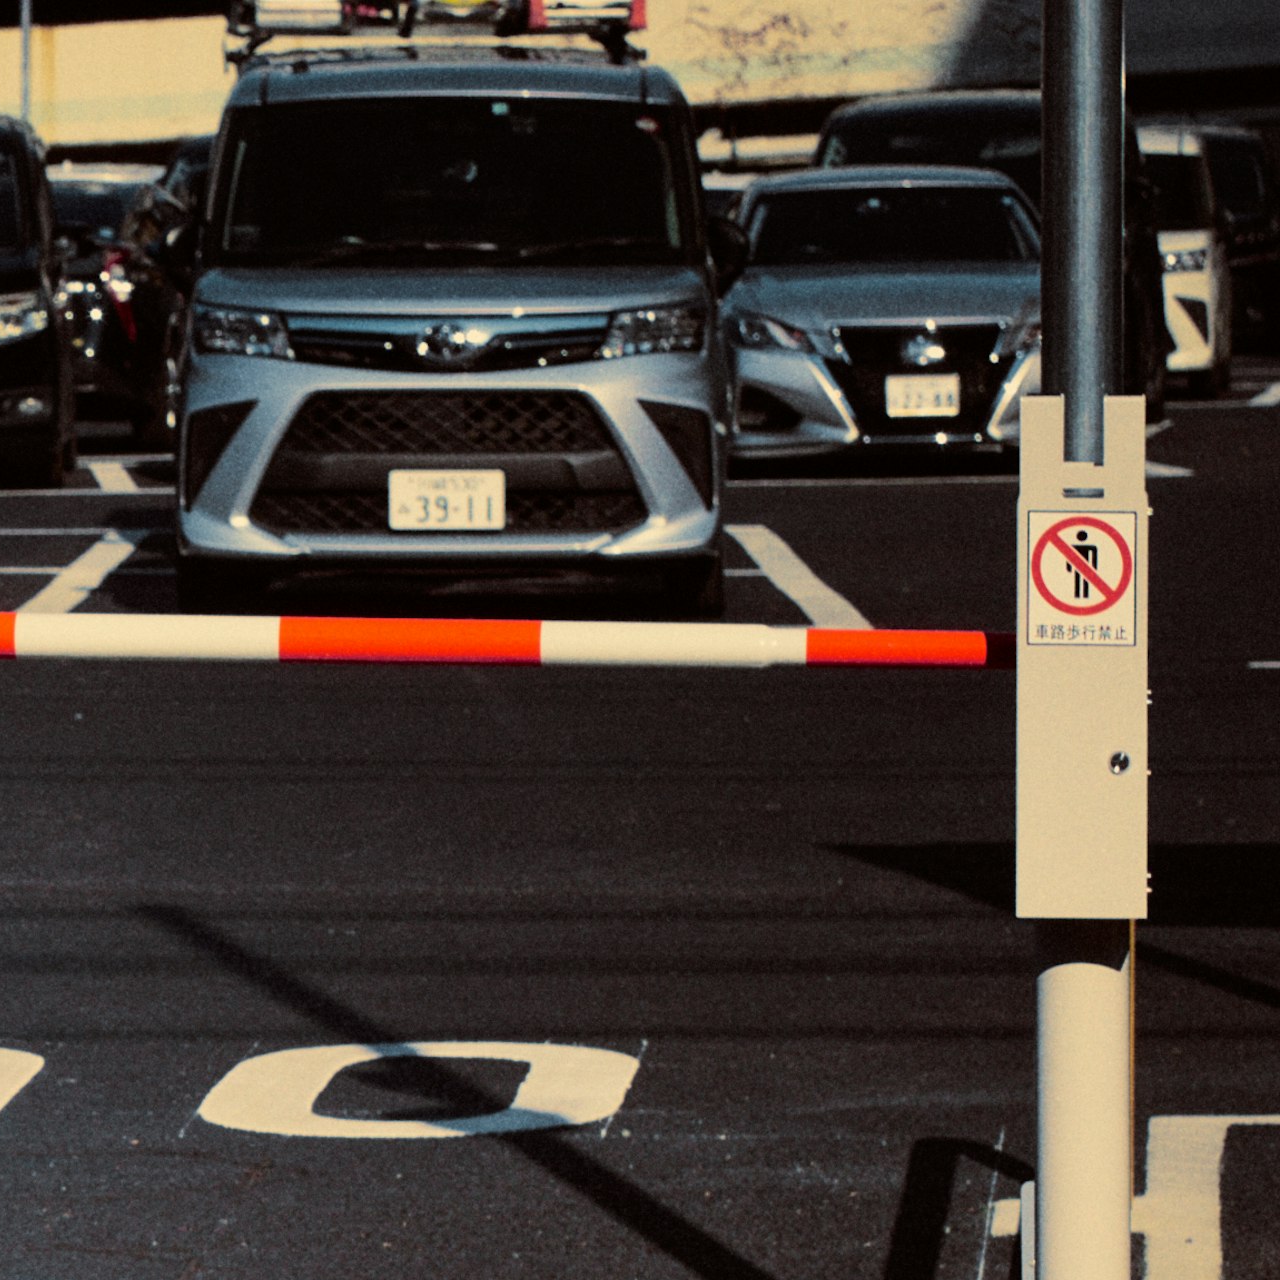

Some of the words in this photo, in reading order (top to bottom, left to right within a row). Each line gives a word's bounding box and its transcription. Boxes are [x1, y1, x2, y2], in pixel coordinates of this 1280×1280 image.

[415, 496, 494, 522] 39-11
[1036, 624, 1128, 640] 車路歩行禁止
